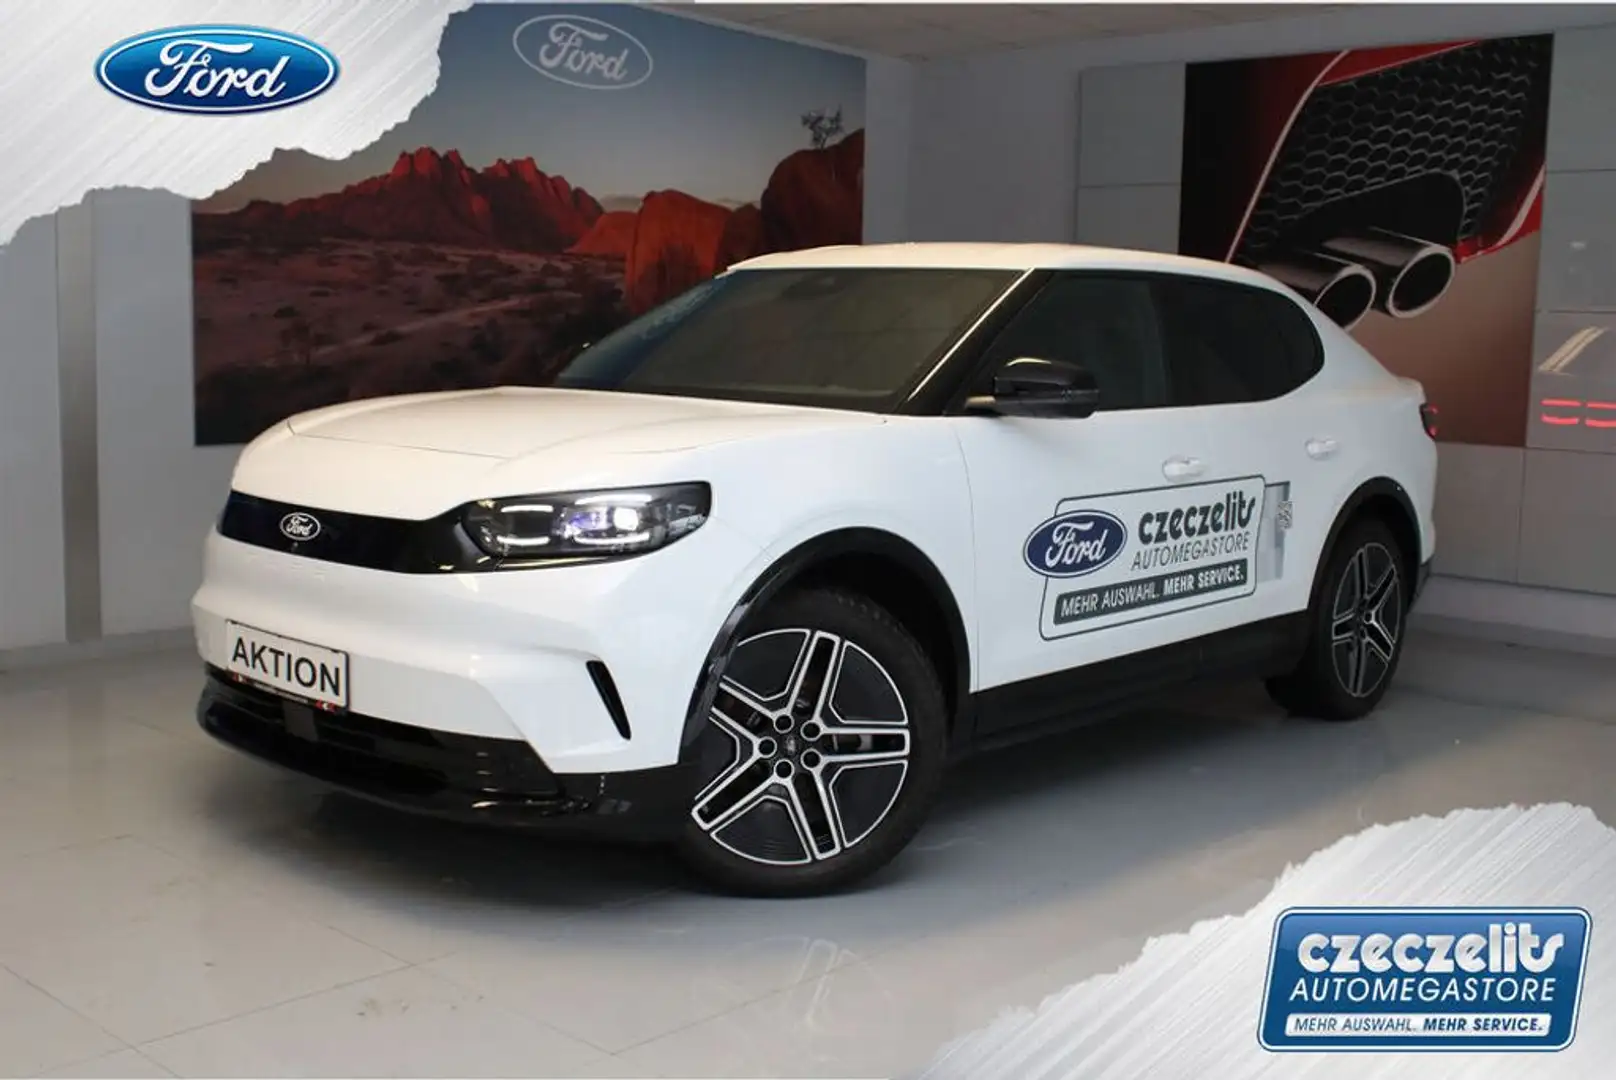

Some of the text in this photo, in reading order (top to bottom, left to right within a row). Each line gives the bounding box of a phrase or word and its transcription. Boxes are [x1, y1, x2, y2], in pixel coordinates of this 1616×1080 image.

[538, 22, 628, 82] Ford
[286, 515, 313, 536] Ford
[1138, 490, 1256, 545] czeczelits
[1045, 520, 1107, 568] Ford
[1131, 531, 1250, 571] AUTOMEGASTORE
[1061, 570, 1244, 617] MEHR AUSWAHL. MEHR SERVICE.
[232, 637, 340, 696] AKTION
